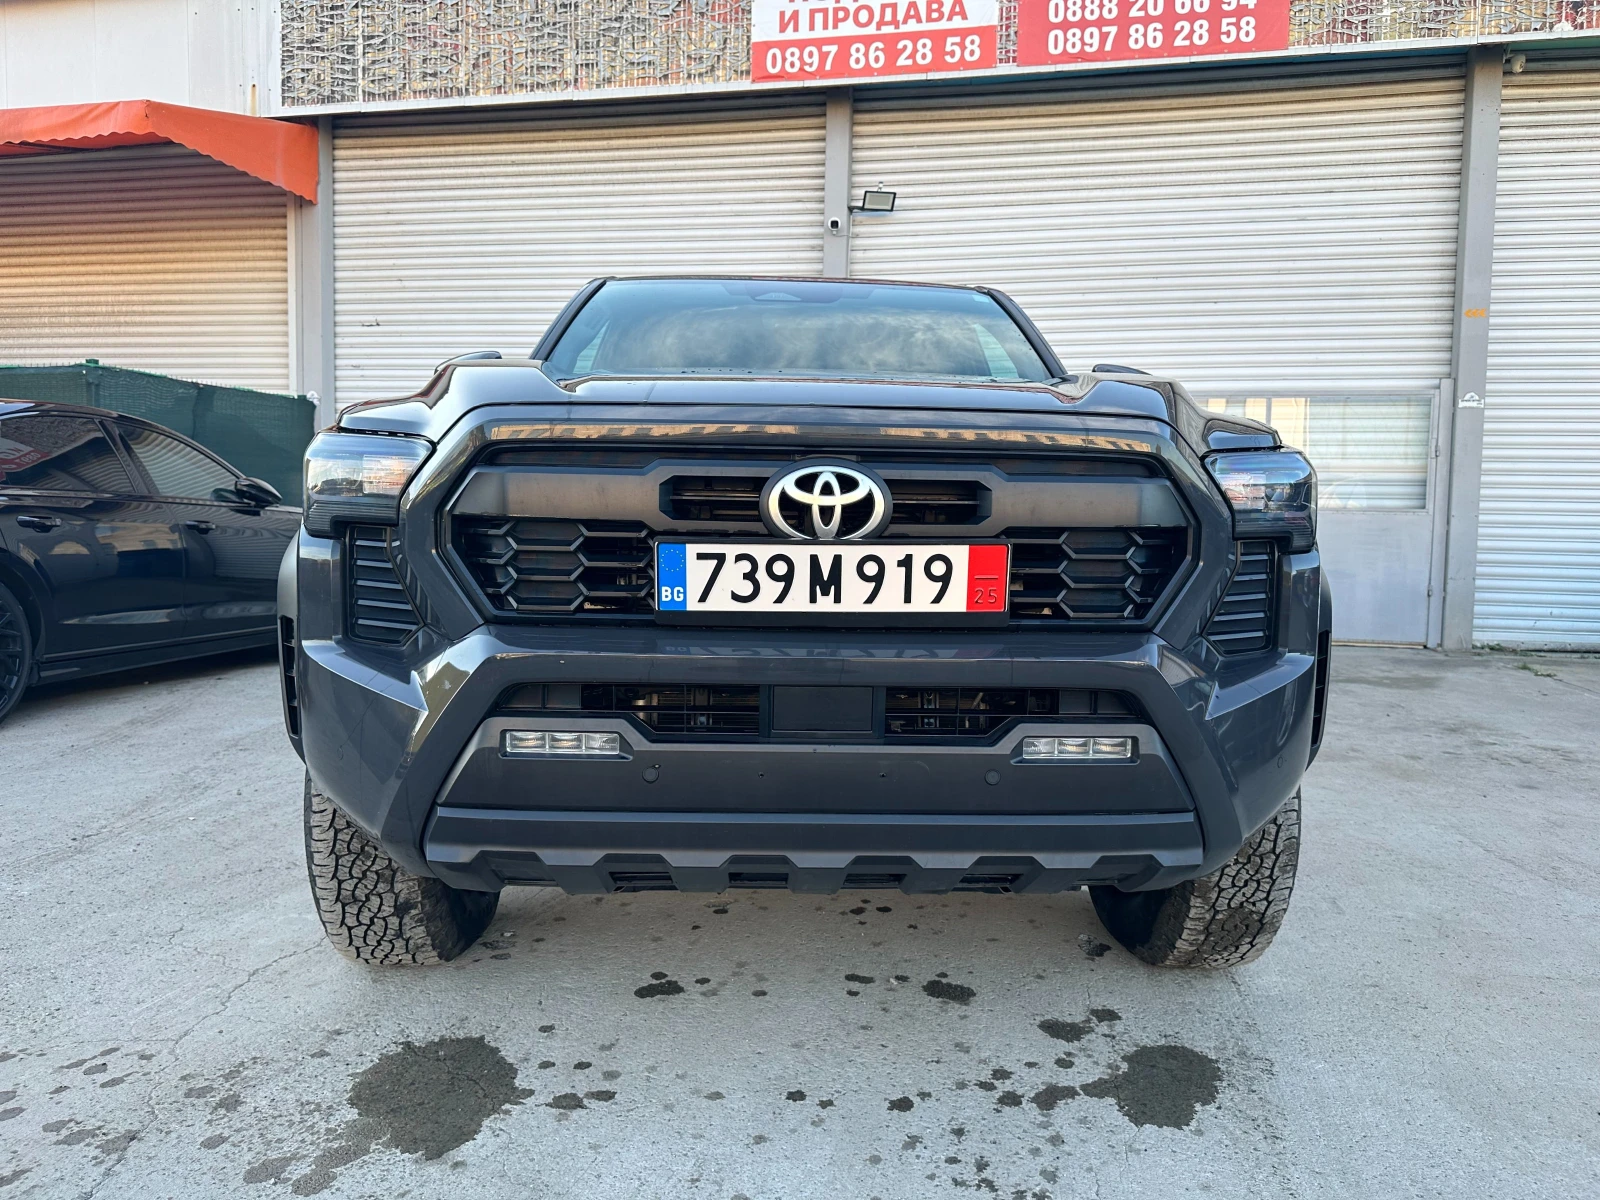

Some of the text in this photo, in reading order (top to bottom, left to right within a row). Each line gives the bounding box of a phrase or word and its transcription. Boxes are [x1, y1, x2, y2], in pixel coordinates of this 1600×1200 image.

[778, 0, 968, 33] И ПРОДАВА
[1048, 0, 1118, 23] 0888
[1128, 0, 1165, 17] 20
[1048, 16, 1257, 55] 0897 86 28 58
[765, 34, 981, 74] 0897 86 28 58
[661, 586, 684, 602] BG
[695, 552, 954, 605] 739 M 919
[974, 588, 998, 605] 25
